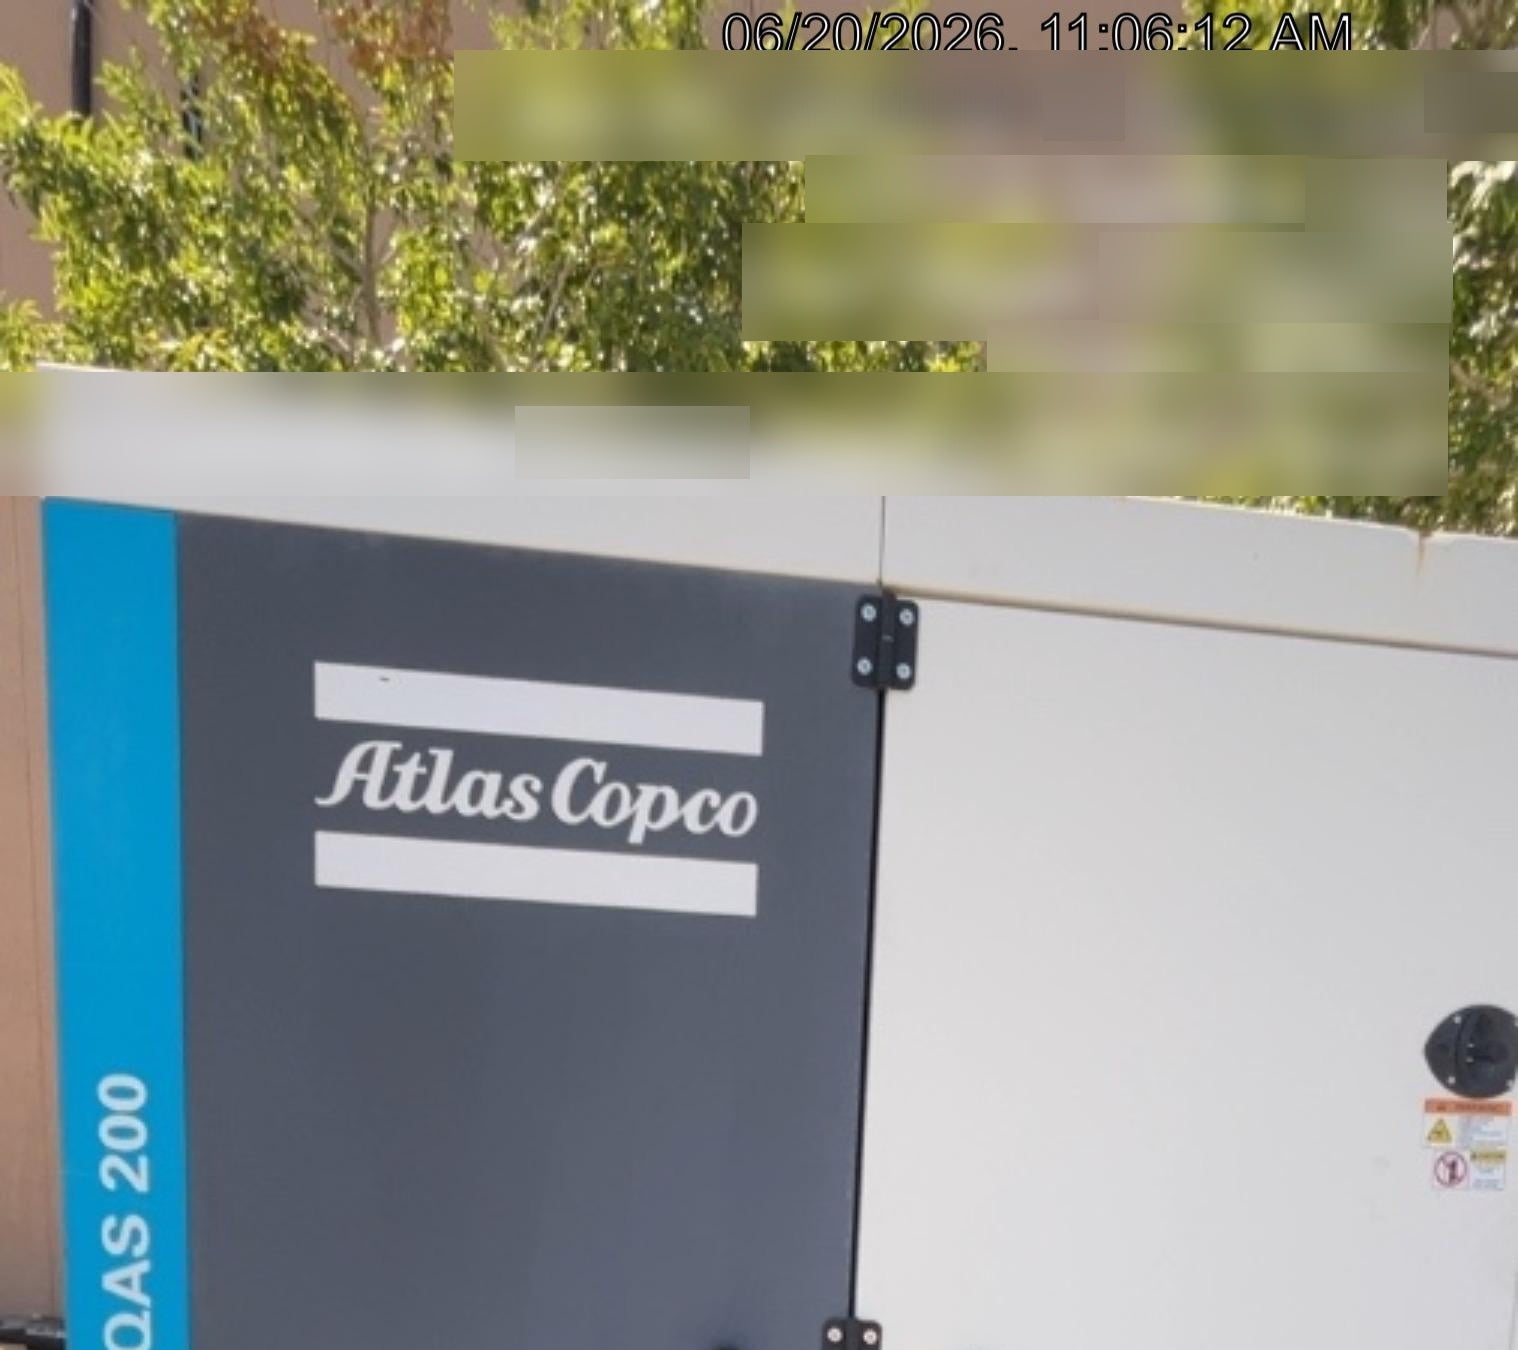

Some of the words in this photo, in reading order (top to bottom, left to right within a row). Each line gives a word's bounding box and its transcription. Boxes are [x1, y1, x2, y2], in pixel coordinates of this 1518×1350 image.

[314, 739, 543, 822] Atlas
[551, 757, 759, 845] Copco
[97, 1073, 149, 1193] 200
